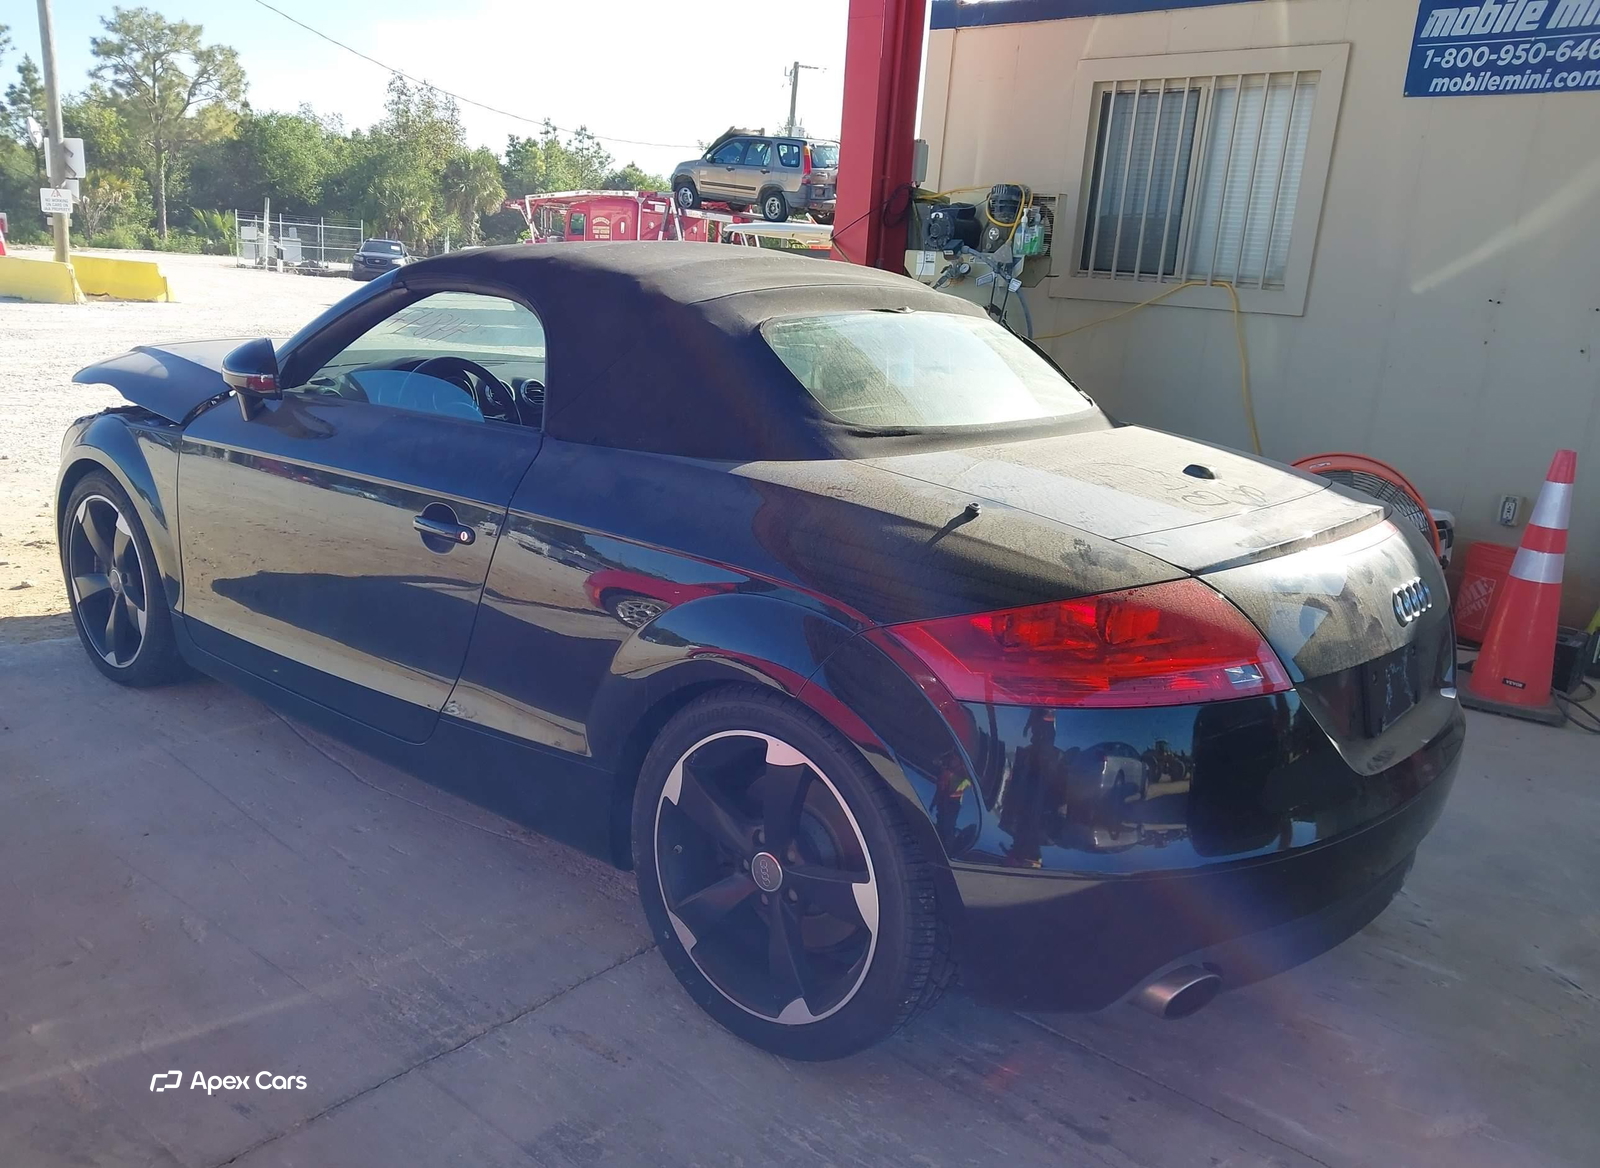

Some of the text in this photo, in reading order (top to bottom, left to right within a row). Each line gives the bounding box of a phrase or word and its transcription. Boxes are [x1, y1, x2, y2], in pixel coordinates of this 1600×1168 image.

[1420, 0, 1548, 38] mobile
[1423, 38, 1600, 69] 1-800-950-646
[1428, 68, 1600, 93] mobilemini.com
